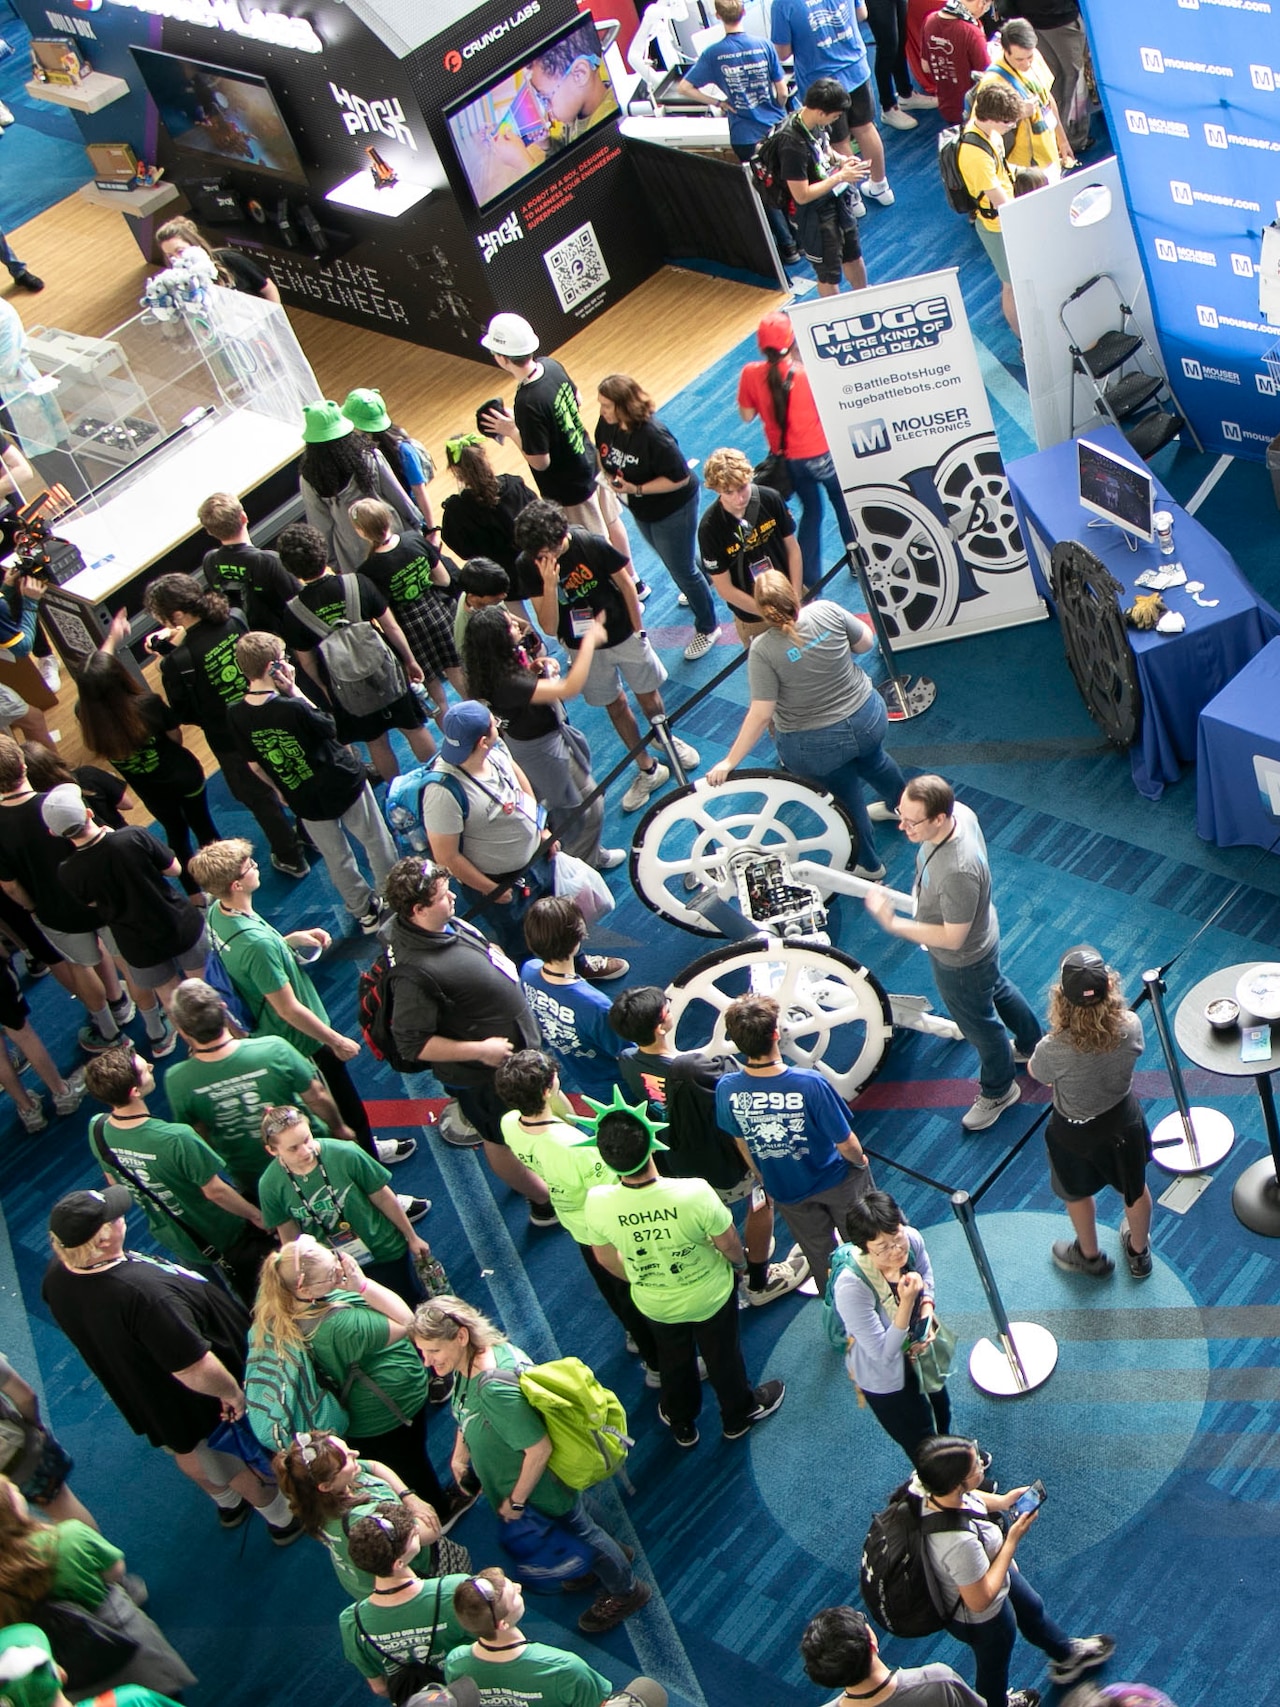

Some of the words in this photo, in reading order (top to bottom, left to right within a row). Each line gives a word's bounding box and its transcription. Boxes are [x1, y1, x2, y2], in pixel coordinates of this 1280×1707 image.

[462, 21, 510, 59] CRUNCH
[509, 0, 541, 28] LABS
[1164, 58, 1233, 77] mouser.com
[1150, 118, 1188, 132] MOUSER
[527, 192, 550, 209] ROBOT
[1193, 190, 1260, 211] mouser.com
[1178, 247, 1215, 261] MOUSER
[270, 264, 409, 325] ENGINEER
[812, 298, 948, 346] HUGE
[825, 336, 878, 355] WE'RE
[881, 327, 919, 342] KIND
[923, 321, 944, 333] OF
[844, 354, 857, 365] A
[860, 347, 888, 360] BIG
[890, 337, 934, 352] DEAL
[842, 363, 951, 395] @BattleBotsHuge
[1203, 366, 1239, 381] MOUSER
[838, 376, 962, 410] hugebattlebots.com
[853, 424, 886, 453] M
[892, 407, 969, 433] MOUSER
[895, 420, 972, 441] ELECTRONICS
[618, 1207, 678, 1227] ROHAN
[633, 1228, 671, 1243] 8721
